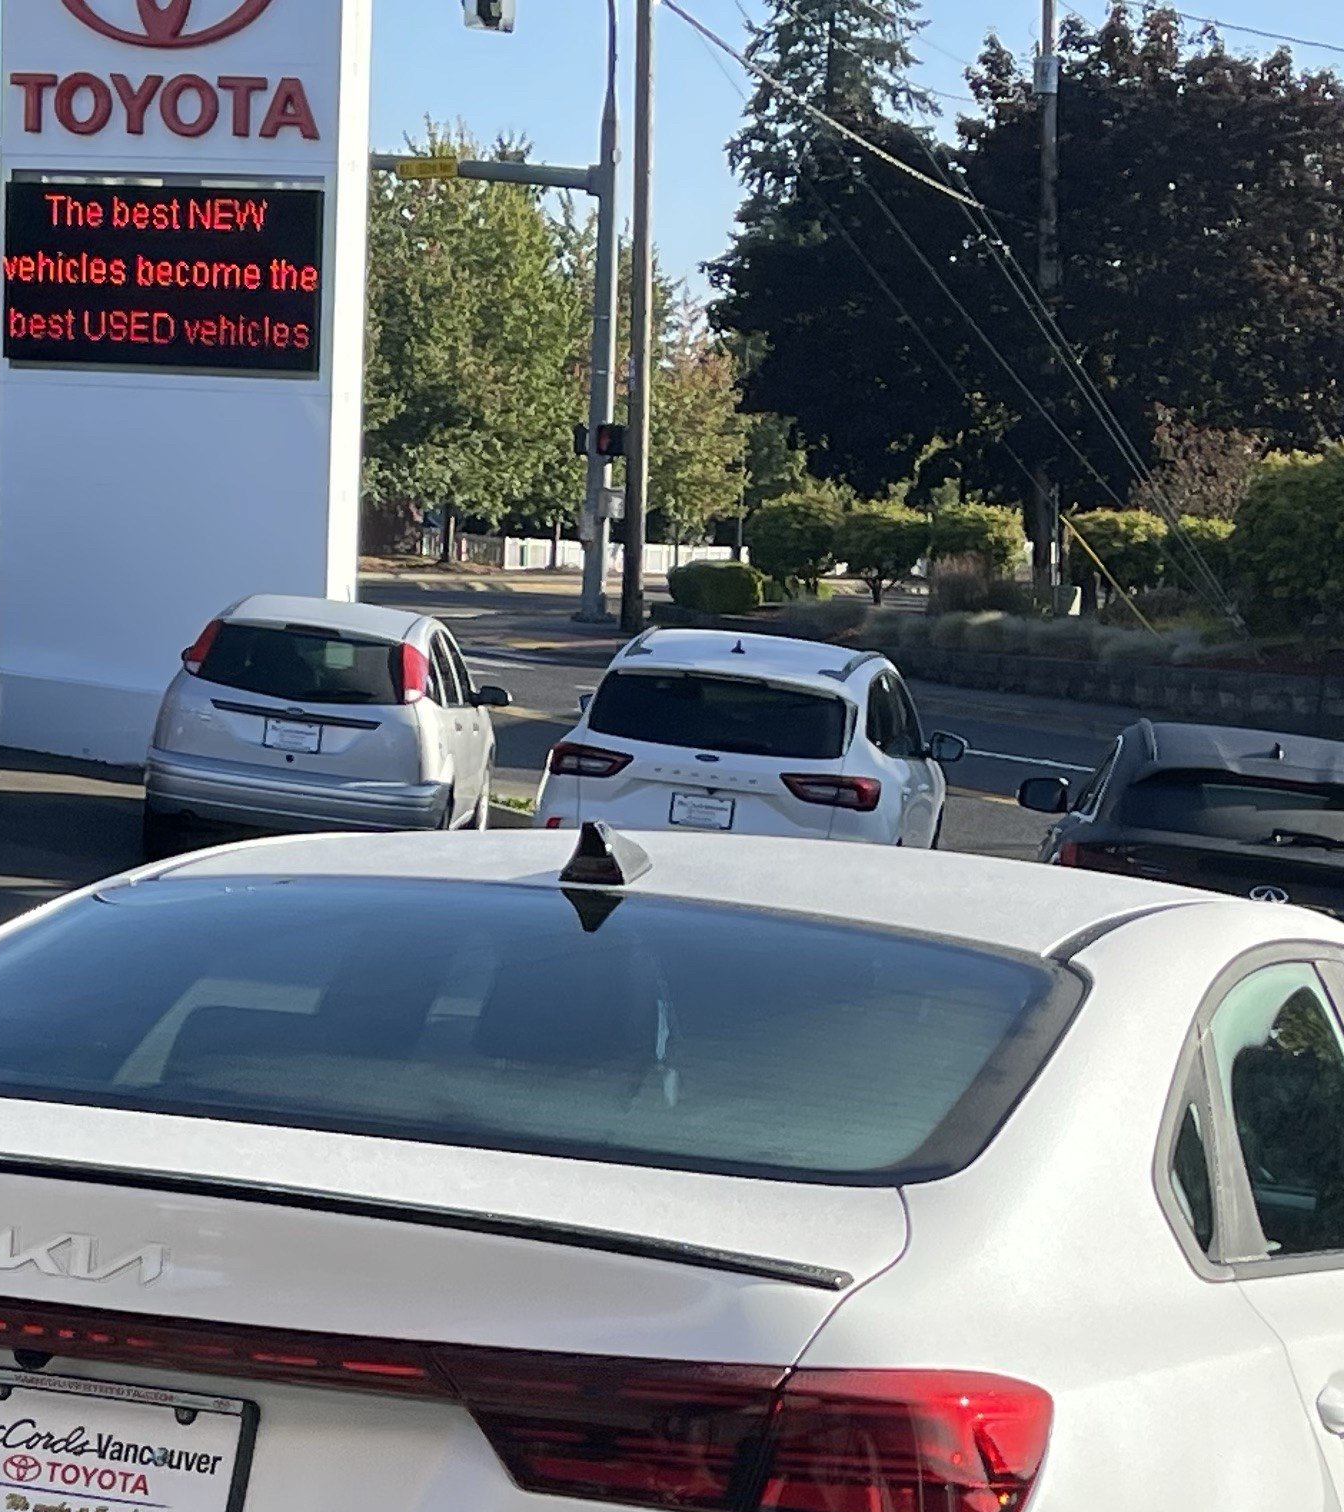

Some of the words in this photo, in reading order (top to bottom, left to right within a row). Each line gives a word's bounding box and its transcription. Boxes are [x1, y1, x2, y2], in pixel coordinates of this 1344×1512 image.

[10, 72, 320, 140] TOYOTA
[45, 194, 104, 227] The
[112, 196, 180, 230] best
[189, 199, 269, 232] NEW
[3, 250, 127, 285] vehicles
[136, 255, 261, 290] become
[270, 259, 319, 293] the
[9, 308, 76, 341] best
[83, 310, 176, 345] USED
[184, 314, 311, 349] vehicles
[46, 1461, 149, 1496] TOYOTA
